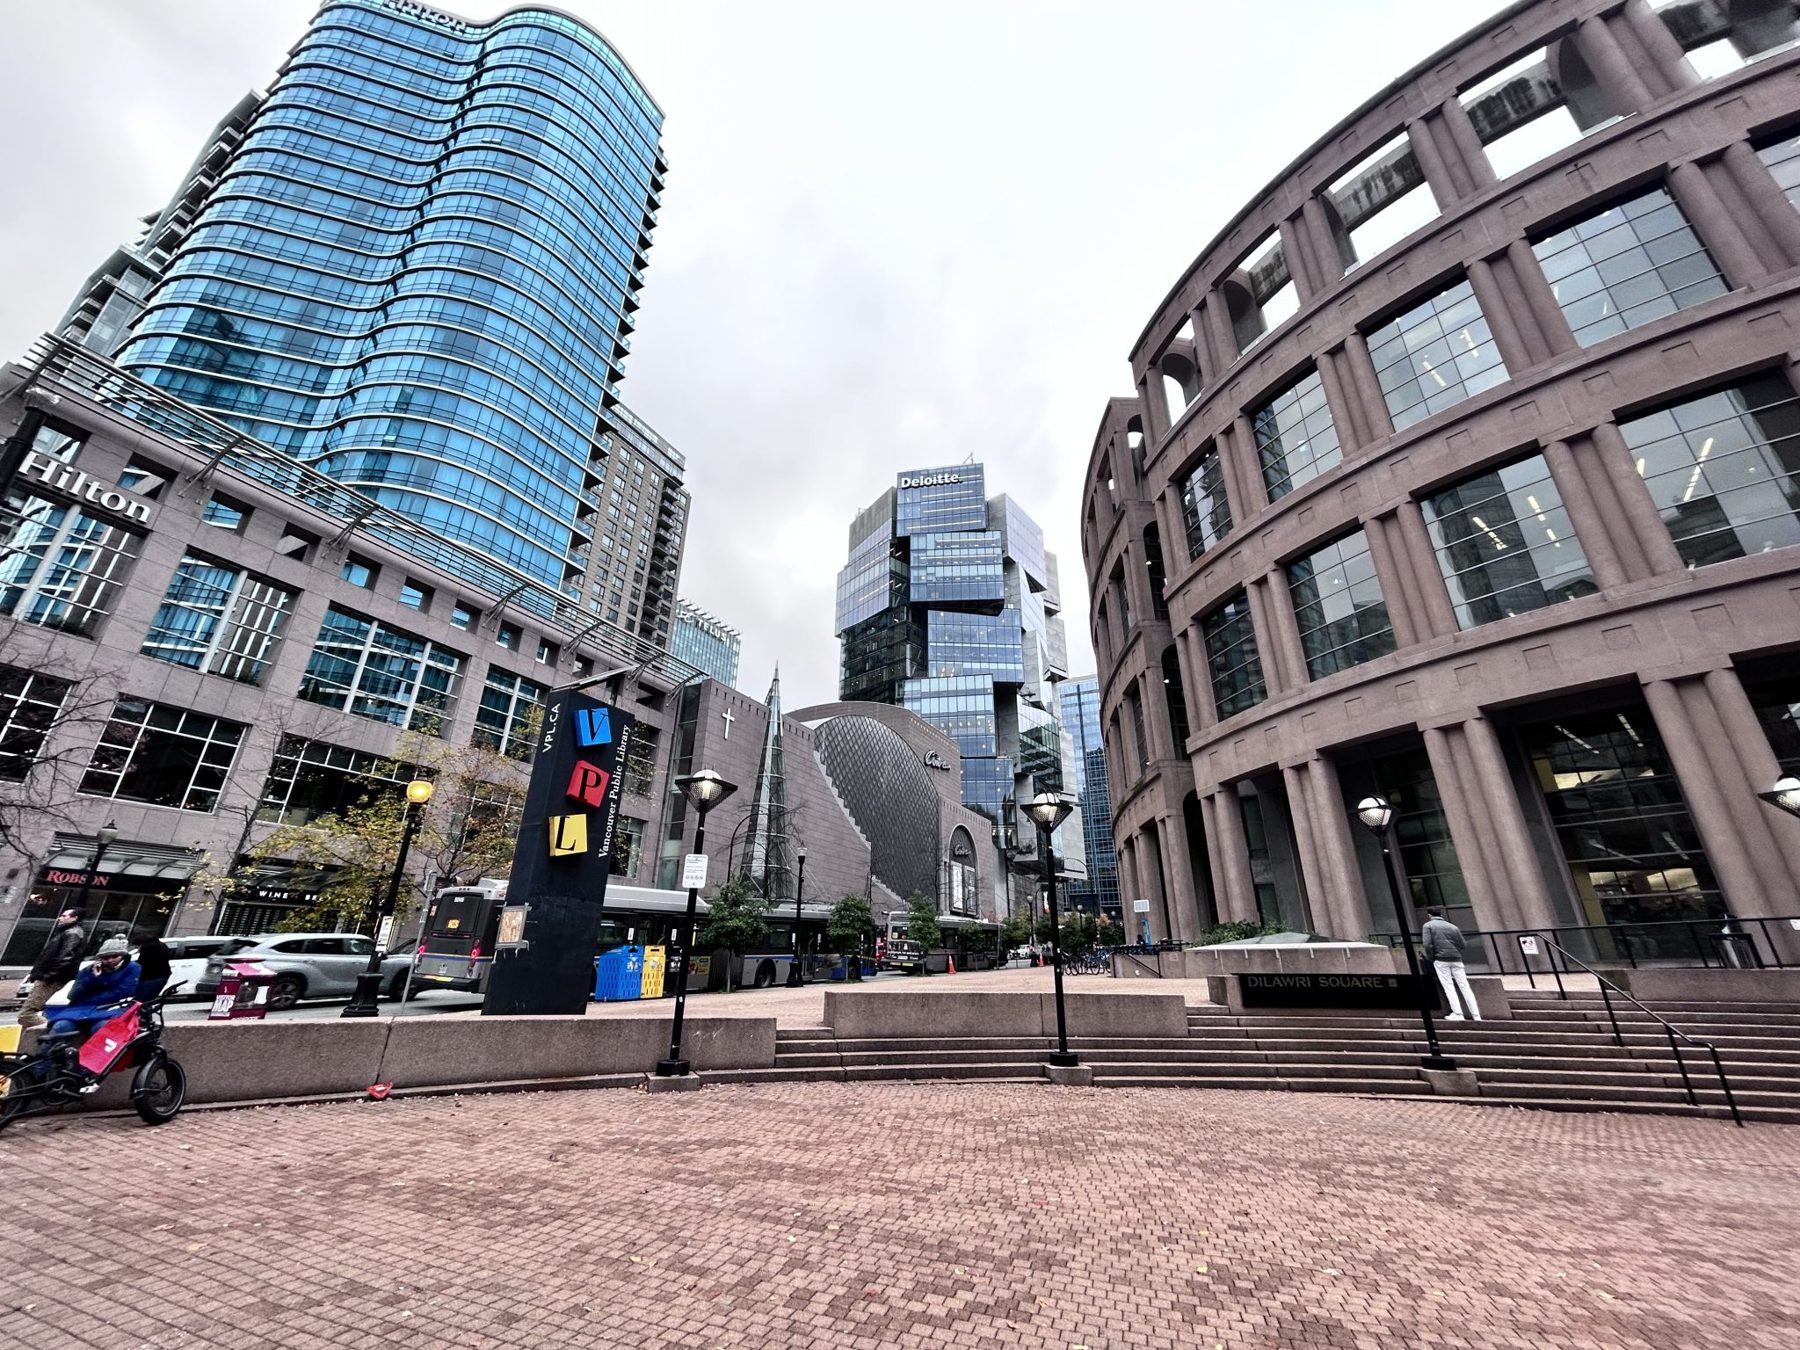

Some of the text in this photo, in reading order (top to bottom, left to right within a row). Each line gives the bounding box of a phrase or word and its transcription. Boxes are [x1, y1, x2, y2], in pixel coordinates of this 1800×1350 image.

[18, 451, 151, 523] Hilton
[698, 618, 727, 642] TELUS
[542, 703, 561, 753] VPL.CA
[598, 724, 632, 858] Vancouver Public Library
[259, 890, 289, 899] WINE
[1247, 976, 1384, 989] DILAWRI SQUARE
